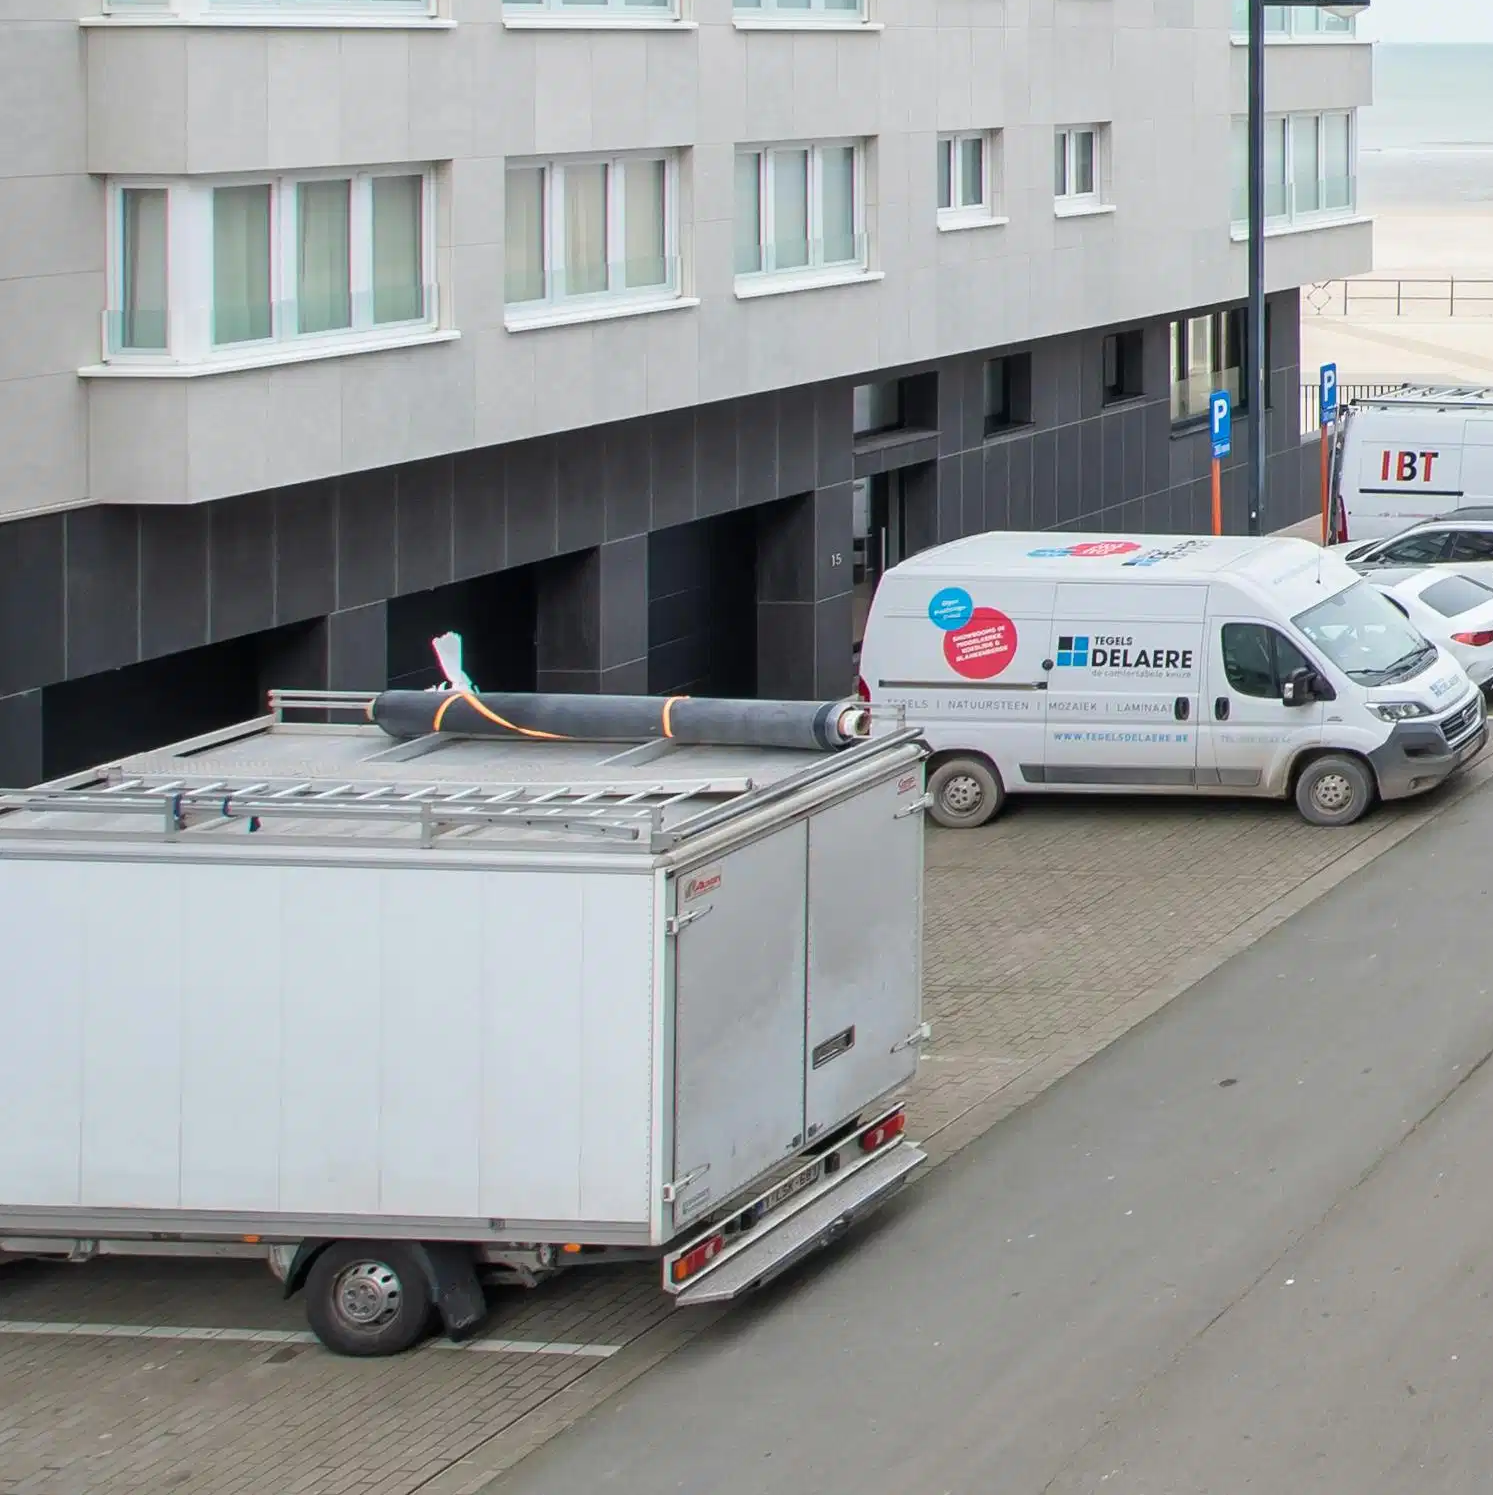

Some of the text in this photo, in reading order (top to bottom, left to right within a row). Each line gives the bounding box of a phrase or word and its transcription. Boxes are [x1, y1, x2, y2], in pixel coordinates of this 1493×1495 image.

[1324, 370, 1335, 402] P
[1213, 399, 1228, 434] P
[1381, 450, 1439, 482] IBT
[831, 553, 842, 567] 15
[1094, 636, 1133, 647] TEGELS
[1091, 648, 1193, 669] DELAERE
[948, 699, 1029, 711] NATUURSTEEN
